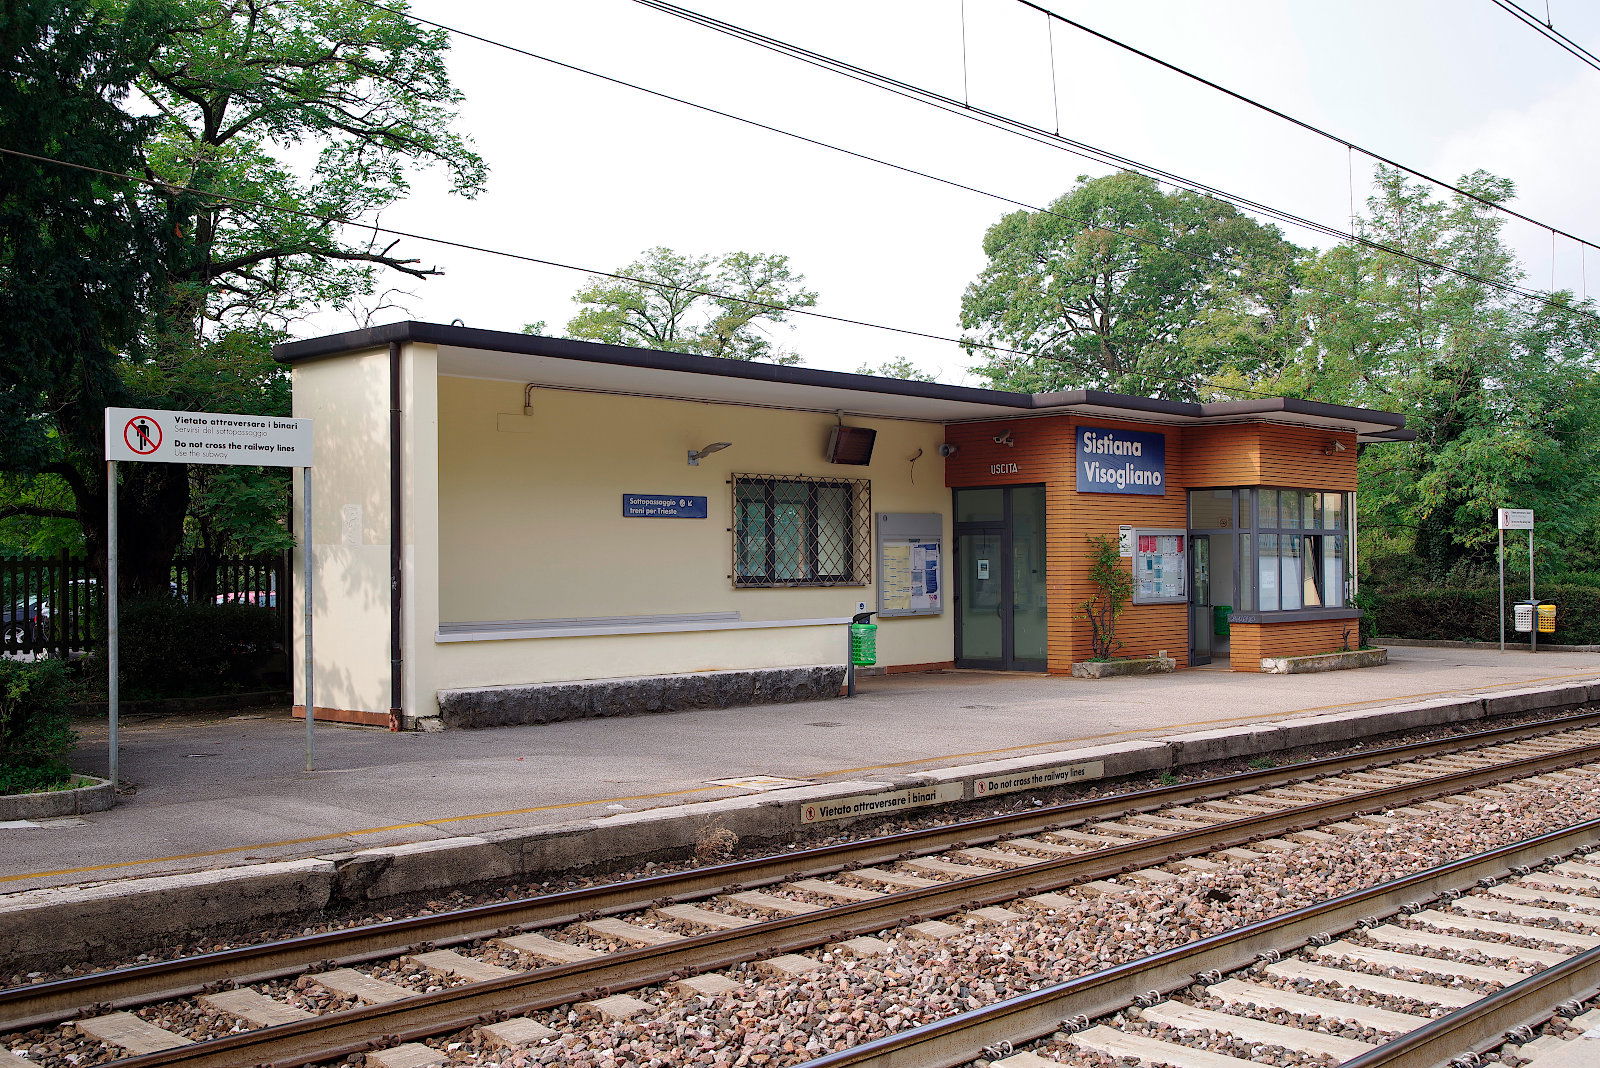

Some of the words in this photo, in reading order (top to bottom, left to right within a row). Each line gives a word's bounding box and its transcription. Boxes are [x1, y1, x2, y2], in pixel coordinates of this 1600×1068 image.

[174, 416, 208, 425] Vietato
[210, 417, 266, 428] attraversare
[273, 421, 298, 430] binari
[174, 425, 200, 434] Servirsi
[216, 428, 268, 439] sottopassaggio
[174, 439, 187, 448] Do
[189, 440, 203, 448] not
[228, 442, 242, 450] the
[244, 442, 275, 453] railway
[277, 444, 295, 452] lines
[1083, 431, 1142, 457] Sistiana
[174, 449, 187, 457] Use
[189, 449, 200, 457] the
[202, 450, 228, 459] subway
[990, 463, 1018, 475] USCITA
[1083, 461, 1162, 489] Visogliano
[629, 497, 676, 507] Sottopassaggio
[988, 781, 999, 791] Do
[1000, 779, 1012, 789] not
[1013, 776, 1031, 788] cross
[1031, 774, 1043, 783] the
[1044, 770, 1069, 782] railway
[1070, 767, 1085, 777] lines
[819, 804, 852, 817] Vietato
[853, 796, 906, 813] attraversare
[907, 791, 911, 804] i
[912, 789, 936, 803] binari
